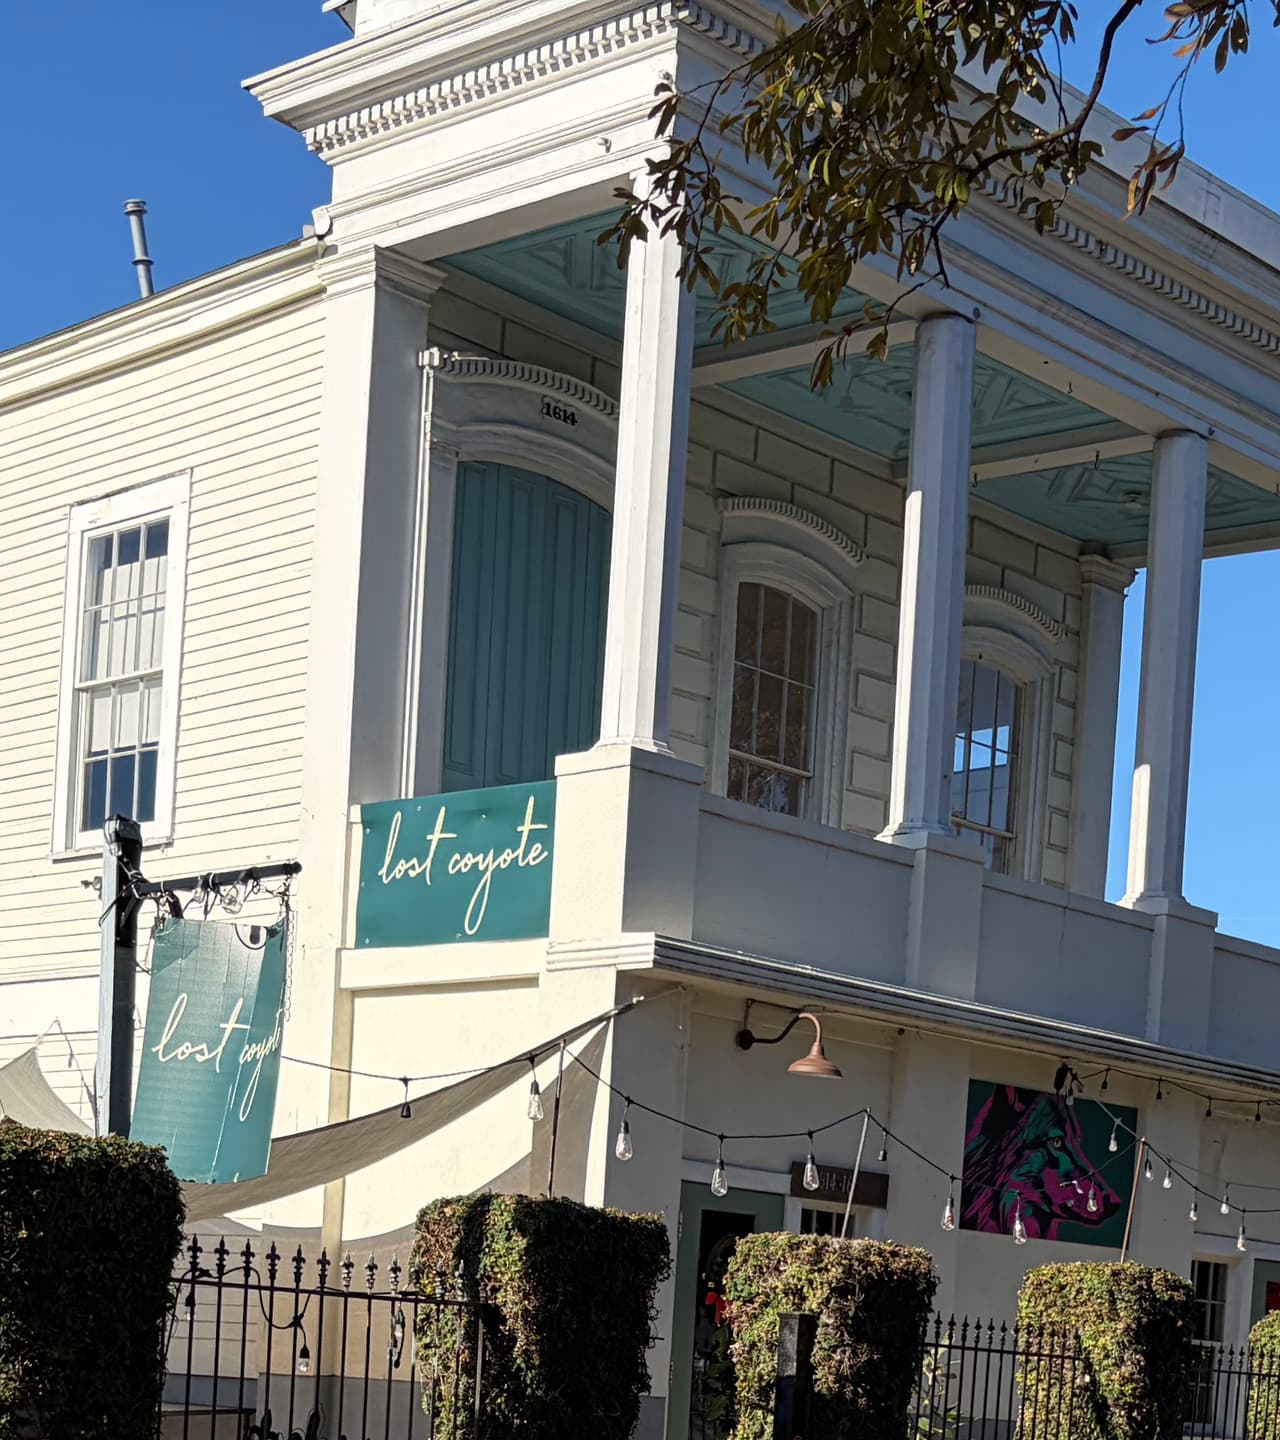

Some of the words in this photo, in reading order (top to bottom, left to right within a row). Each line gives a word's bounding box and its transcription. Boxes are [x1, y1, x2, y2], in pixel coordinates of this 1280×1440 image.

[543, 402, 578, 427] 1614
[378, 806, 457, 886] lost
[448, 795, 548, 936] coyote
[152, 992, 251, 1073] lost
